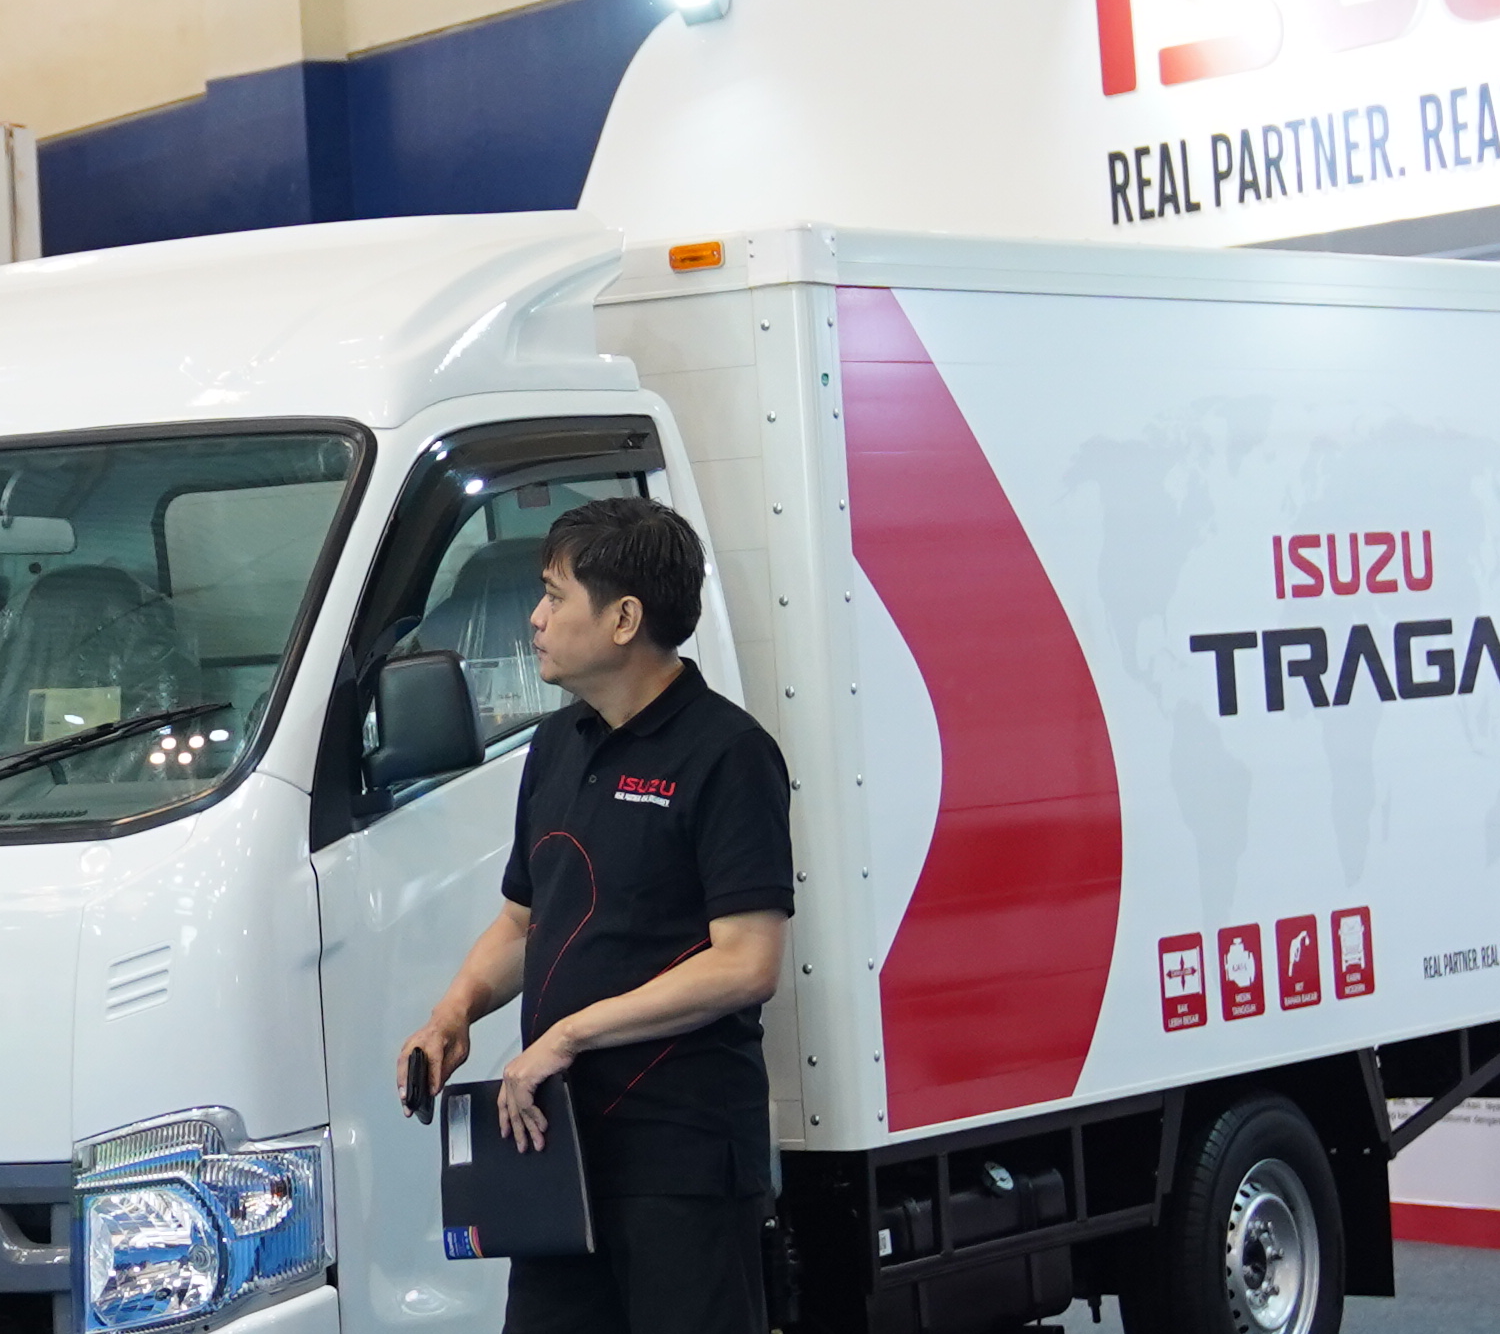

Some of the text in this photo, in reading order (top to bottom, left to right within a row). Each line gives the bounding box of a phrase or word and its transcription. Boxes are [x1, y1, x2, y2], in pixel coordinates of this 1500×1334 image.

[1107, 131, 1202, 225] REAL
[1211, 101, 1407, 208] PARTNER.
[1272, 529, 1434, 599] ISUZU
[617, 774, 677, 797] ISUZU
[1423, 955, 1443, 979] REAL
[1443, 948, 1480, 977] PARTNER.
[1481, 943, 1500, 968] REAL
